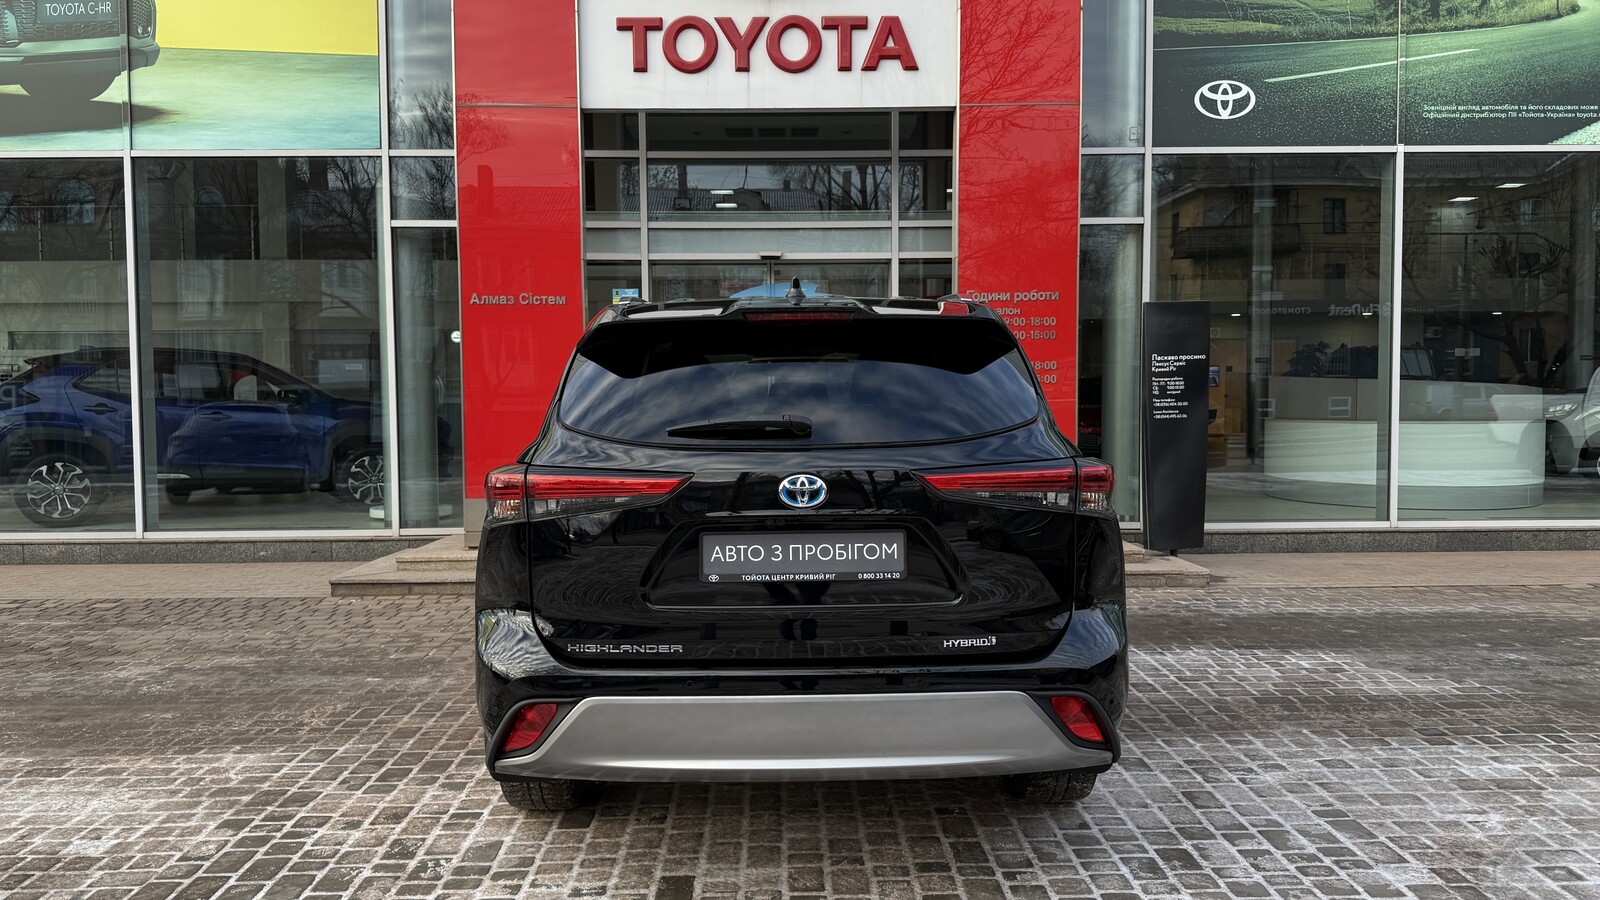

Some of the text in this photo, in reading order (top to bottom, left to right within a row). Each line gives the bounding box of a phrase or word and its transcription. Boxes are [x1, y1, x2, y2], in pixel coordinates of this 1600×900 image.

[44, 1, 112, 16] TOYOTA C-HR
[616, 15, 919, 74] TOYOTA
[470, 293, 566, 305] Алмаз Сістем
[1014, 290, 1060, 303] роботи
[996, 307, 1021, 315] алон
[1003, 317, 1057, 326] 9:00-18:00
[710, 543, 898, 562] АВТО З ПРОБІГОМ
[741, 573, 770, 581] ТОЙОТА
[795, 572, 825, 580] КРИВИЙ
[567, 643, 683, 653] HIGHLANDER
[943, 638, 988, 648] HYBRID
